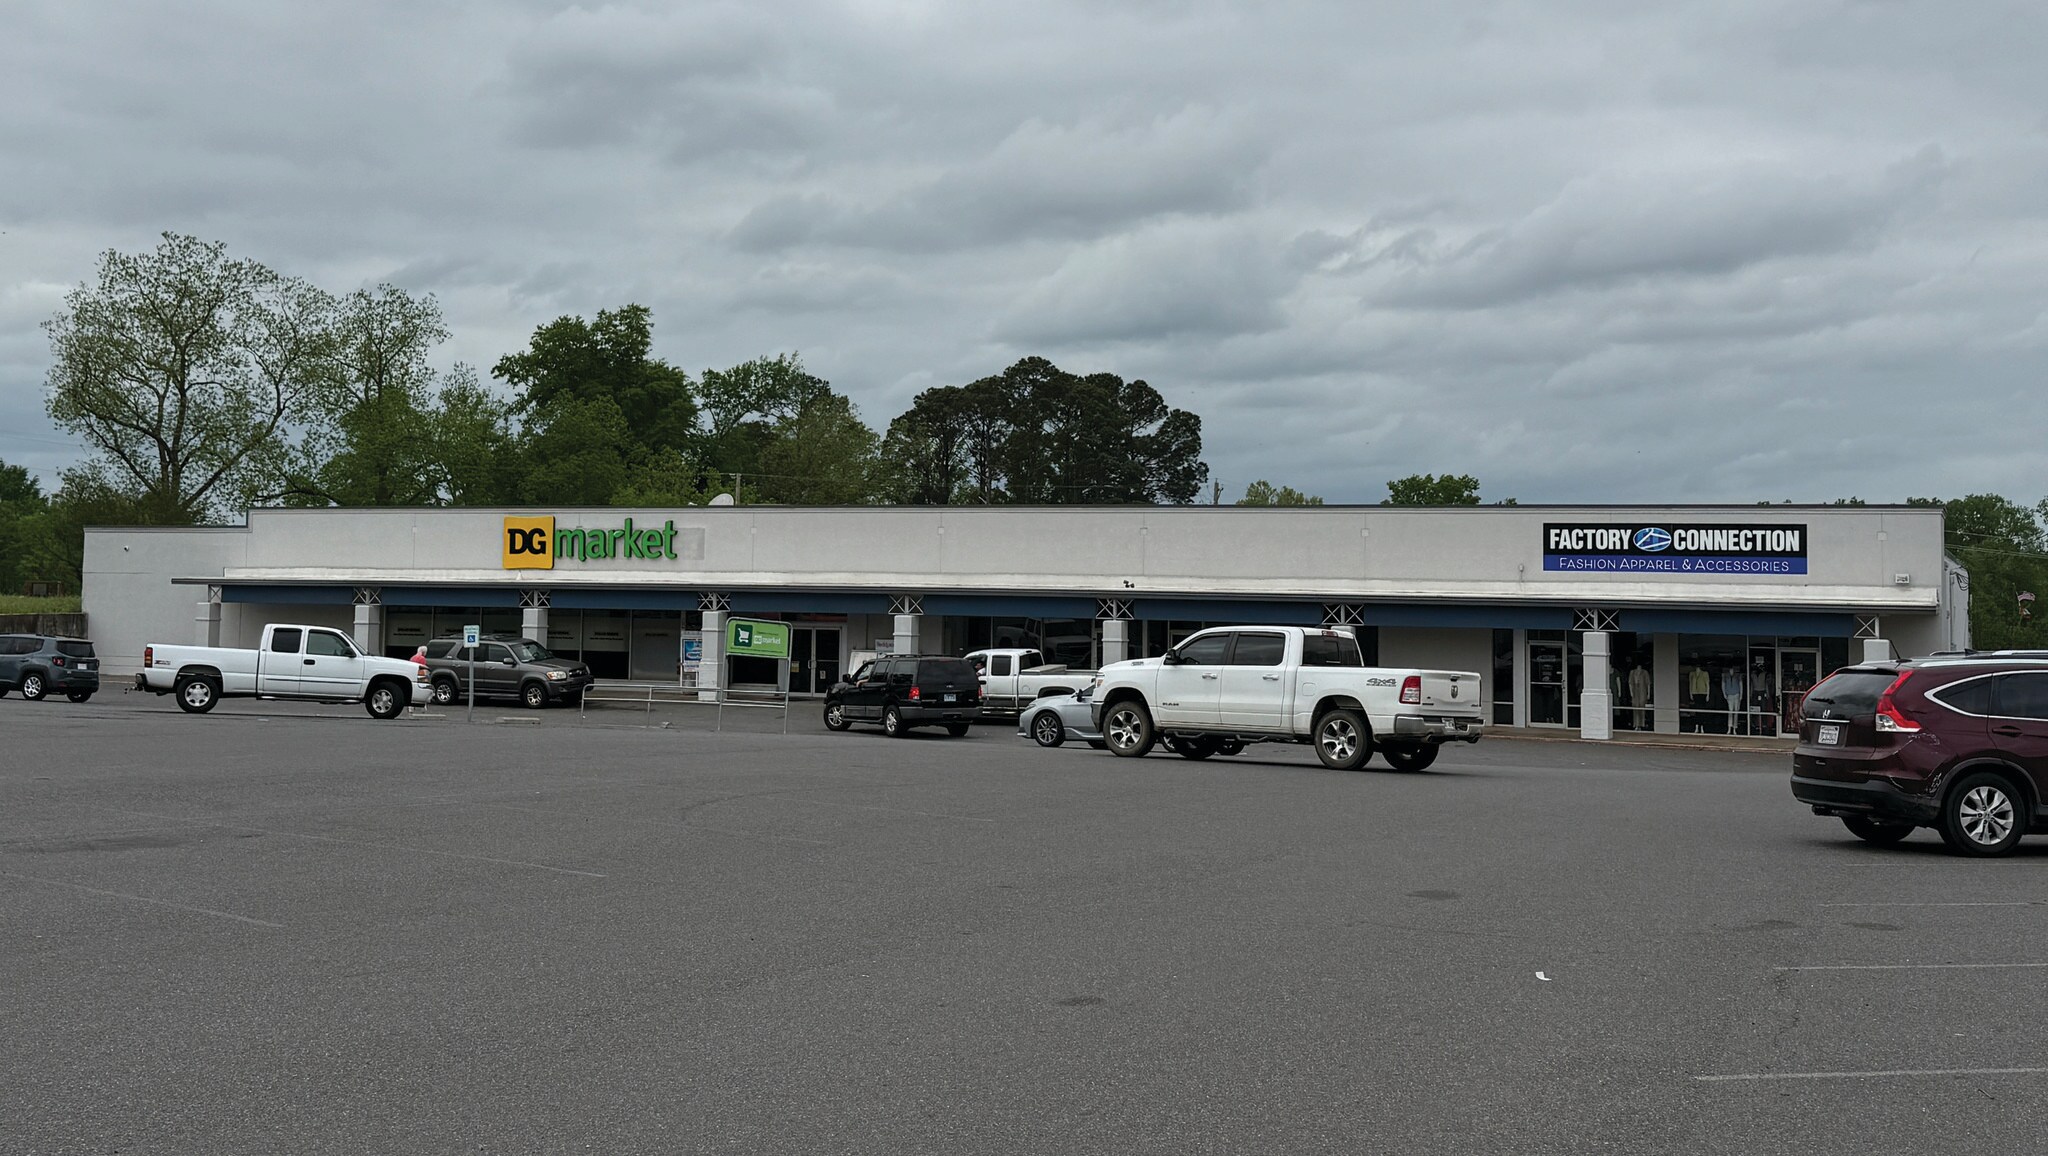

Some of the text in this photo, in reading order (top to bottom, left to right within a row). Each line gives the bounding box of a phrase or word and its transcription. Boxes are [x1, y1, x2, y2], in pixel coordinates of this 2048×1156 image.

[507, 517, 678, 562] DG market
[1549, 528, 1800, 551] FACTORY CONNECTION
[1559, 557, 1790, 572] FASHION APPAREL & ACCESSORIES
